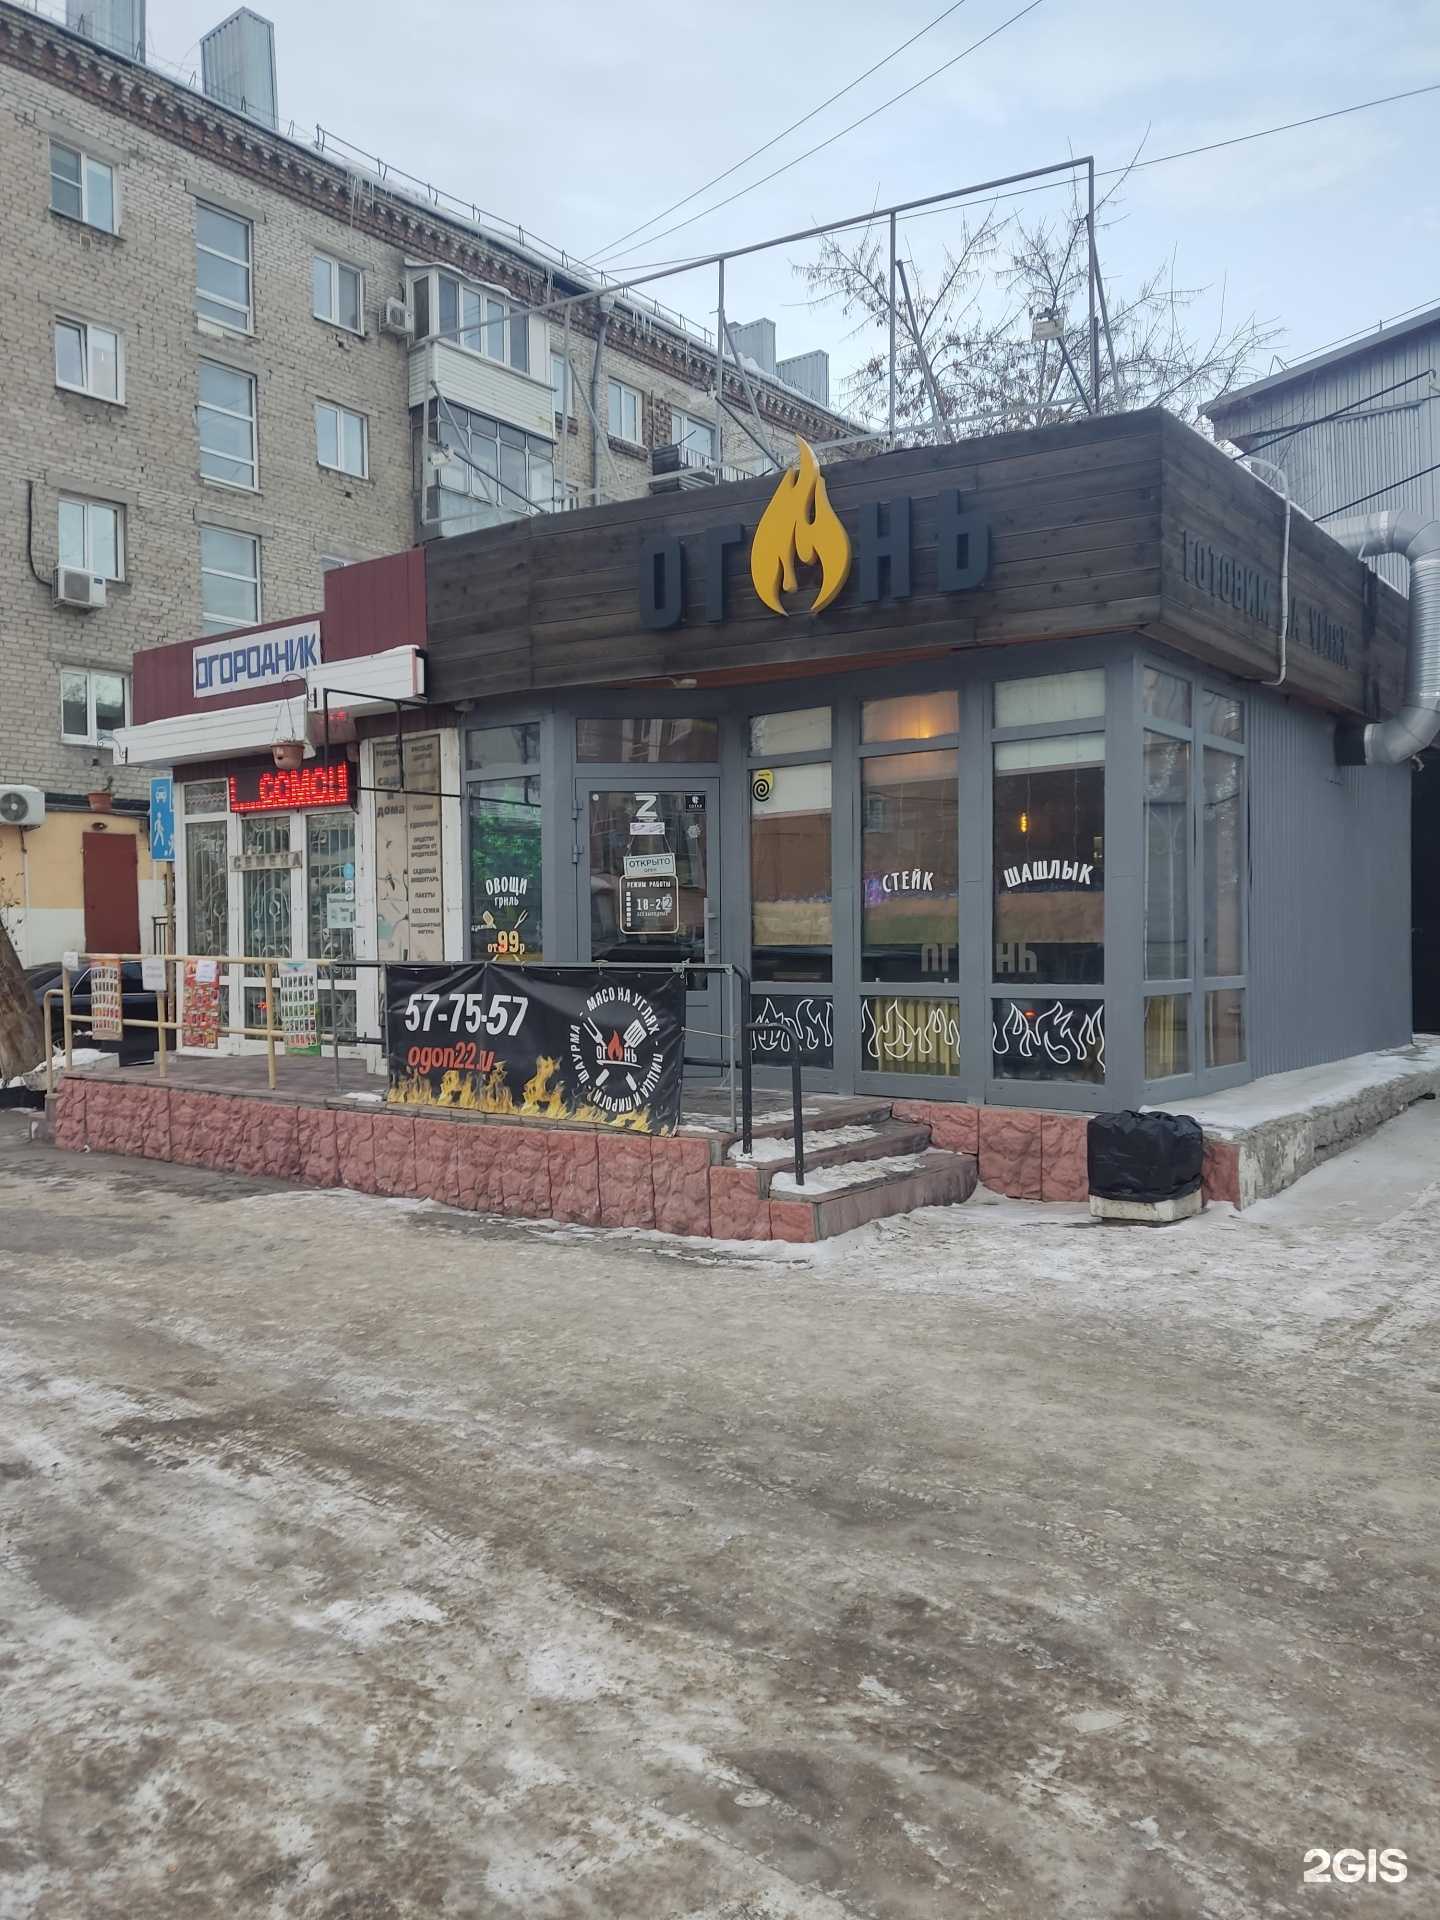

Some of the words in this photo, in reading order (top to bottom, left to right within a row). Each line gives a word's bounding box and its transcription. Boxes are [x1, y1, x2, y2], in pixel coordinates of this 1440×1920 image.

[195, 633, 318, 690] ОГОРОДНИК
[233, 853, 300, 870] СЕМЕНА
[629, 857, 671, 868] ОТКРЫТО
[1003, 859, 1094, 888] ШАШЛЫК
[485, 876, 528, 896] ОВОЩИ
[649, 880, 671, 888] РАБОТЫ
[882, 868, 934, 893] СТЕЙК
[495, 897, 519, 909] гриль
[405, 993, 529, 1036] 57-75-57
[586, 986, 616, 1012] МЯСО
[617, 986, 631, 1003] НА
[632, 992, 660, 1035] УГЛЯХ
[569, 1024, 590, 1084] ШАУРМА
[640, 1053, 664, 1098] ПИЦЦА
[592, 1089, 633, 1112] ПИРОГИ
[632, 1091, 642, 1106] И
